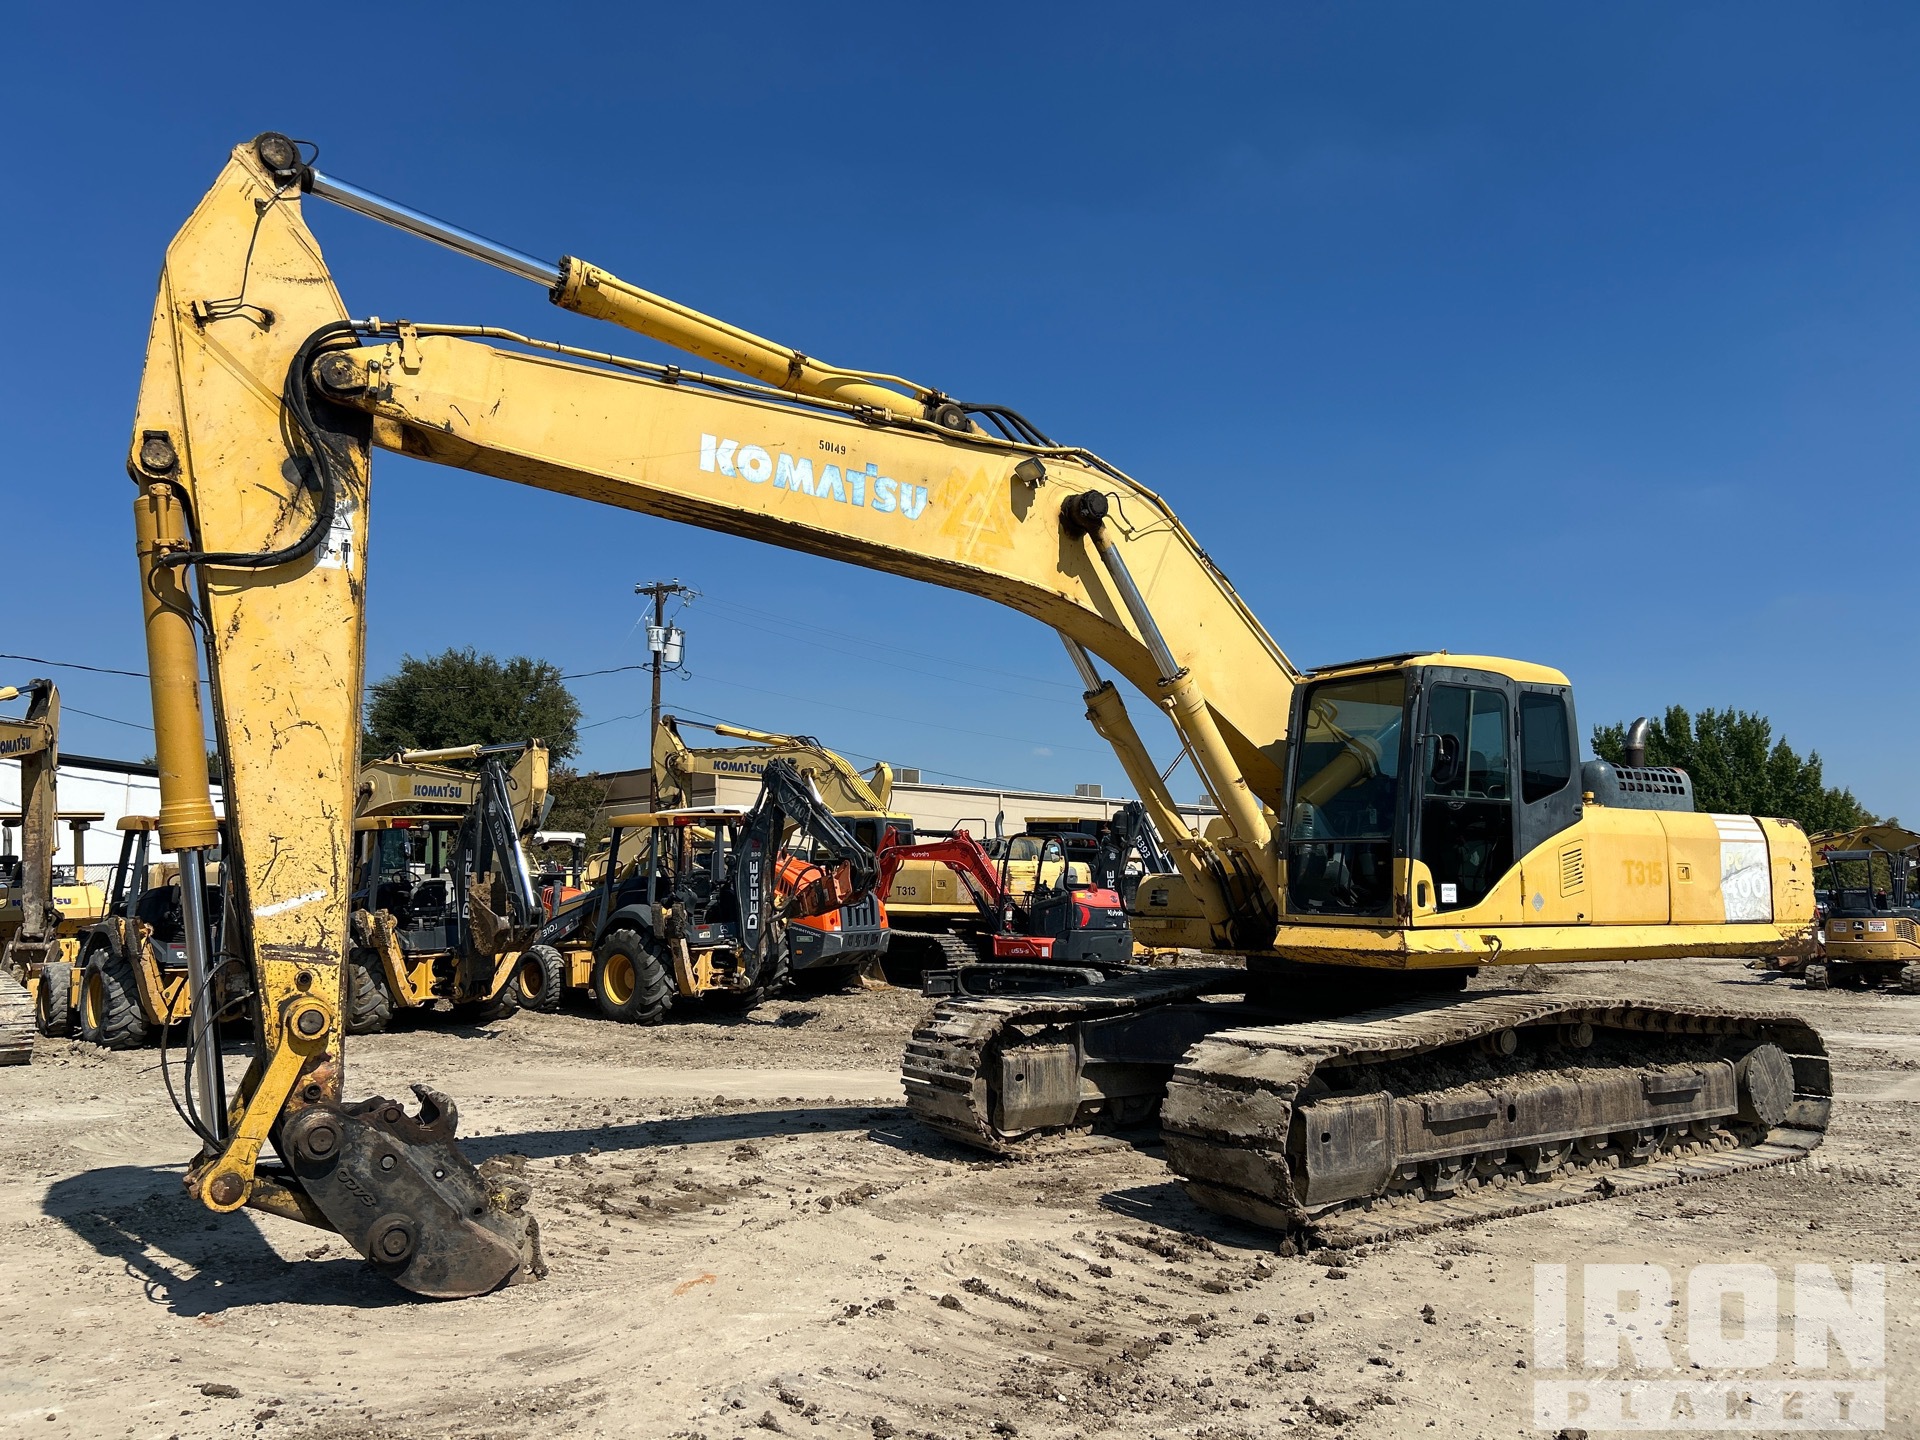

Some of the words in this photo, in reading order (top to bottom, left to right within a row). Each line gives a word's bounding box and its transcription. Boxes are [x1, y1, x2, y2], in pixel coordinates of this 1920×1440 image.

[819, 440, 846, 455] 50149
[699, 433, 928, 520] KOMATSU
[0, 734, 31, 754] OMATSU
[713, 760, 764, 774] KOMATSU
[414, 783, 462, 798] KOMATSU
[1725, 852, 1744, 870] PC
[1622, 859, 1663, 887] T315
[462, 848, 473, 919] DEERE
[896, 886, 916, 896] T313
[1723, 871, 1765, 898] 400
[747, 861, 759, 930] DEERE
[542, 923, 558, 938] 310J
